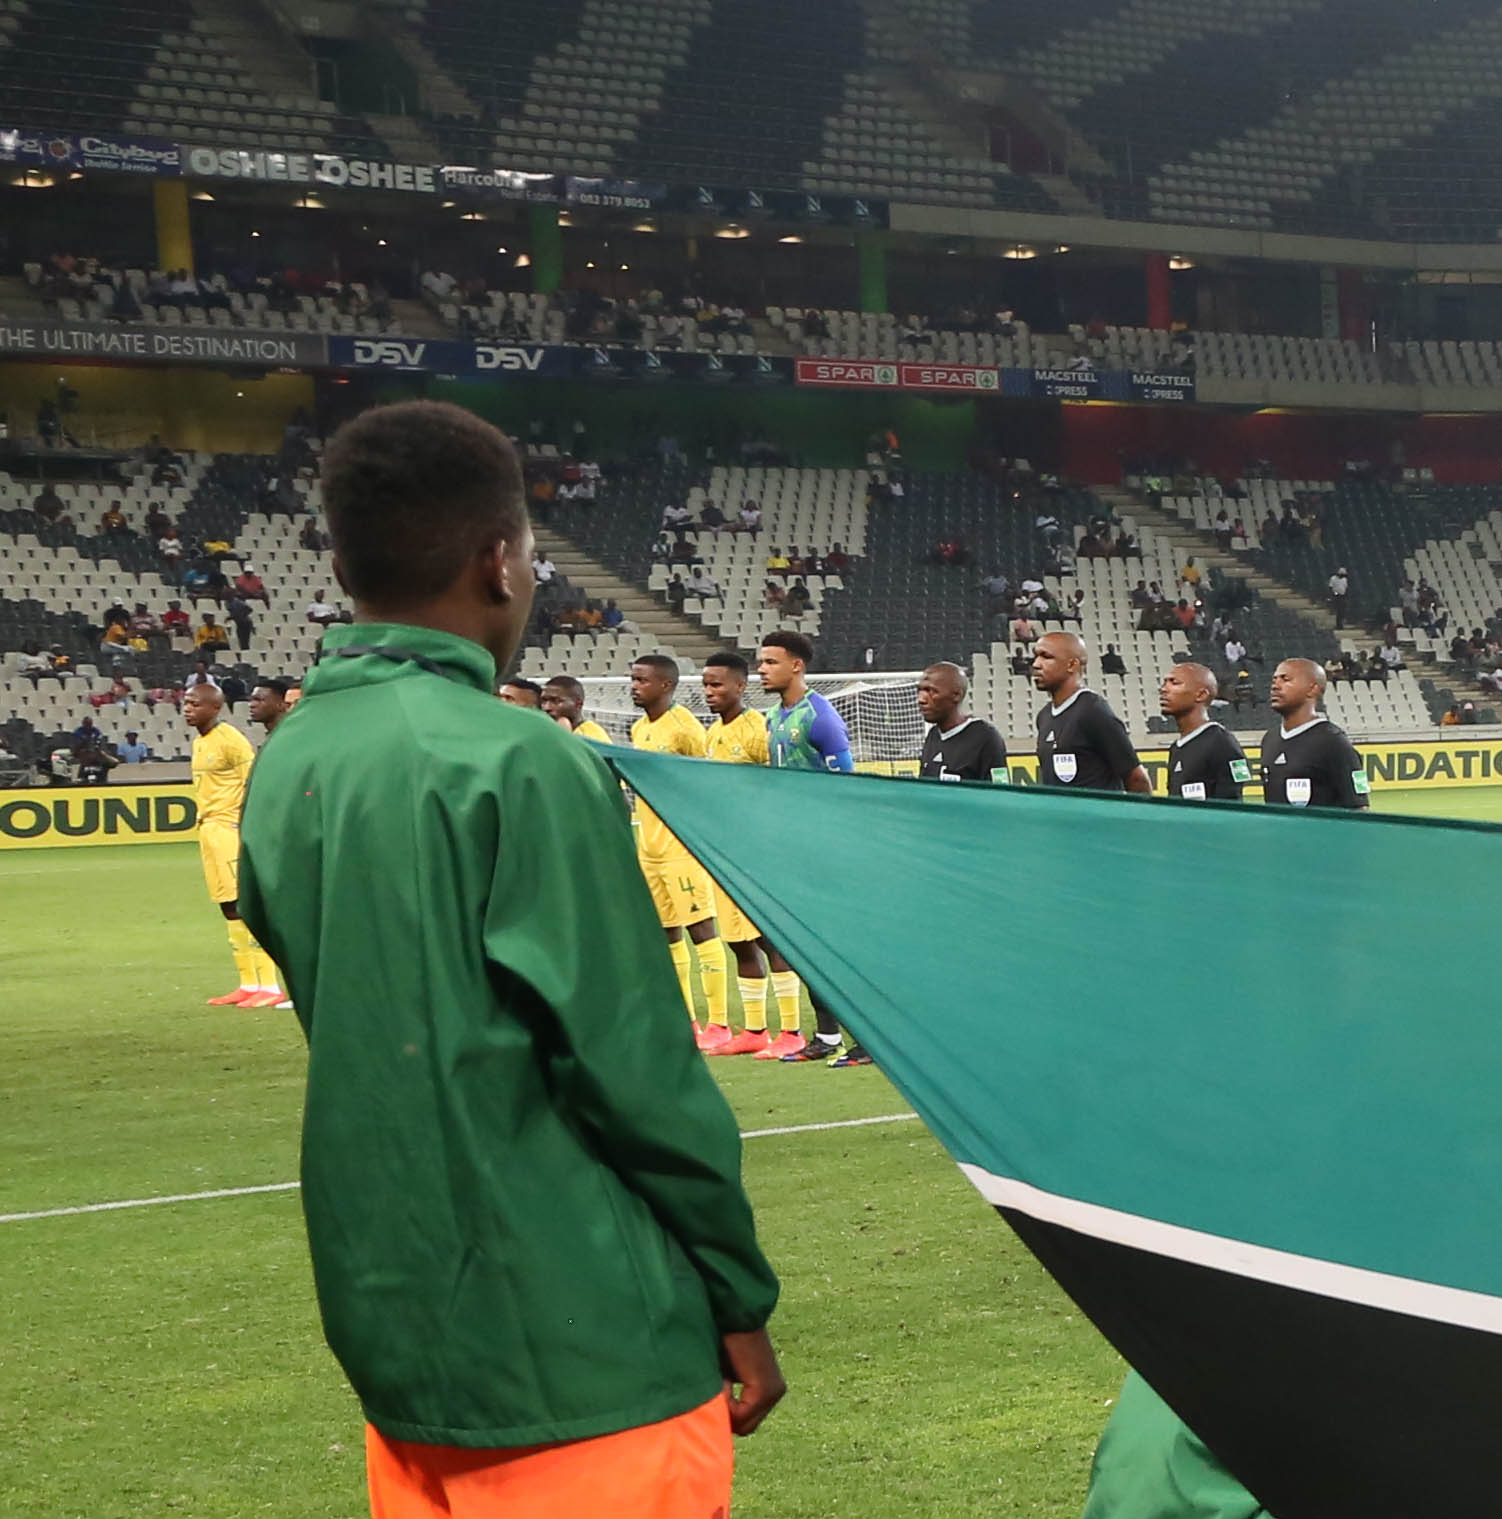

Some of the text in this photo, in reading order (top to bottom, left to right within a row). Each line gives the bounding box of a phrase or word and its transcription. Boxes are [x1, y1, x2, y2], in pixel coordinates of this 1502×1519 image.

[190, 149, 309, 182] OSHEE
[320, 158, 435, 193] OSHEE
[0, 327, 296, 360] THE ULTIMATE DESTINATION
[354, 341, 425, 365] DSV
[476, 346, 545, 370] DSV
[816, 365, 873, 380] SPAR
[920, 370, 976, 385] SPAR
[1035, 370, 1098, 383] MACSTEEL
[1132, 374, 1193, 387] MACSTEEL
[679, 876, 695, 897] 4
